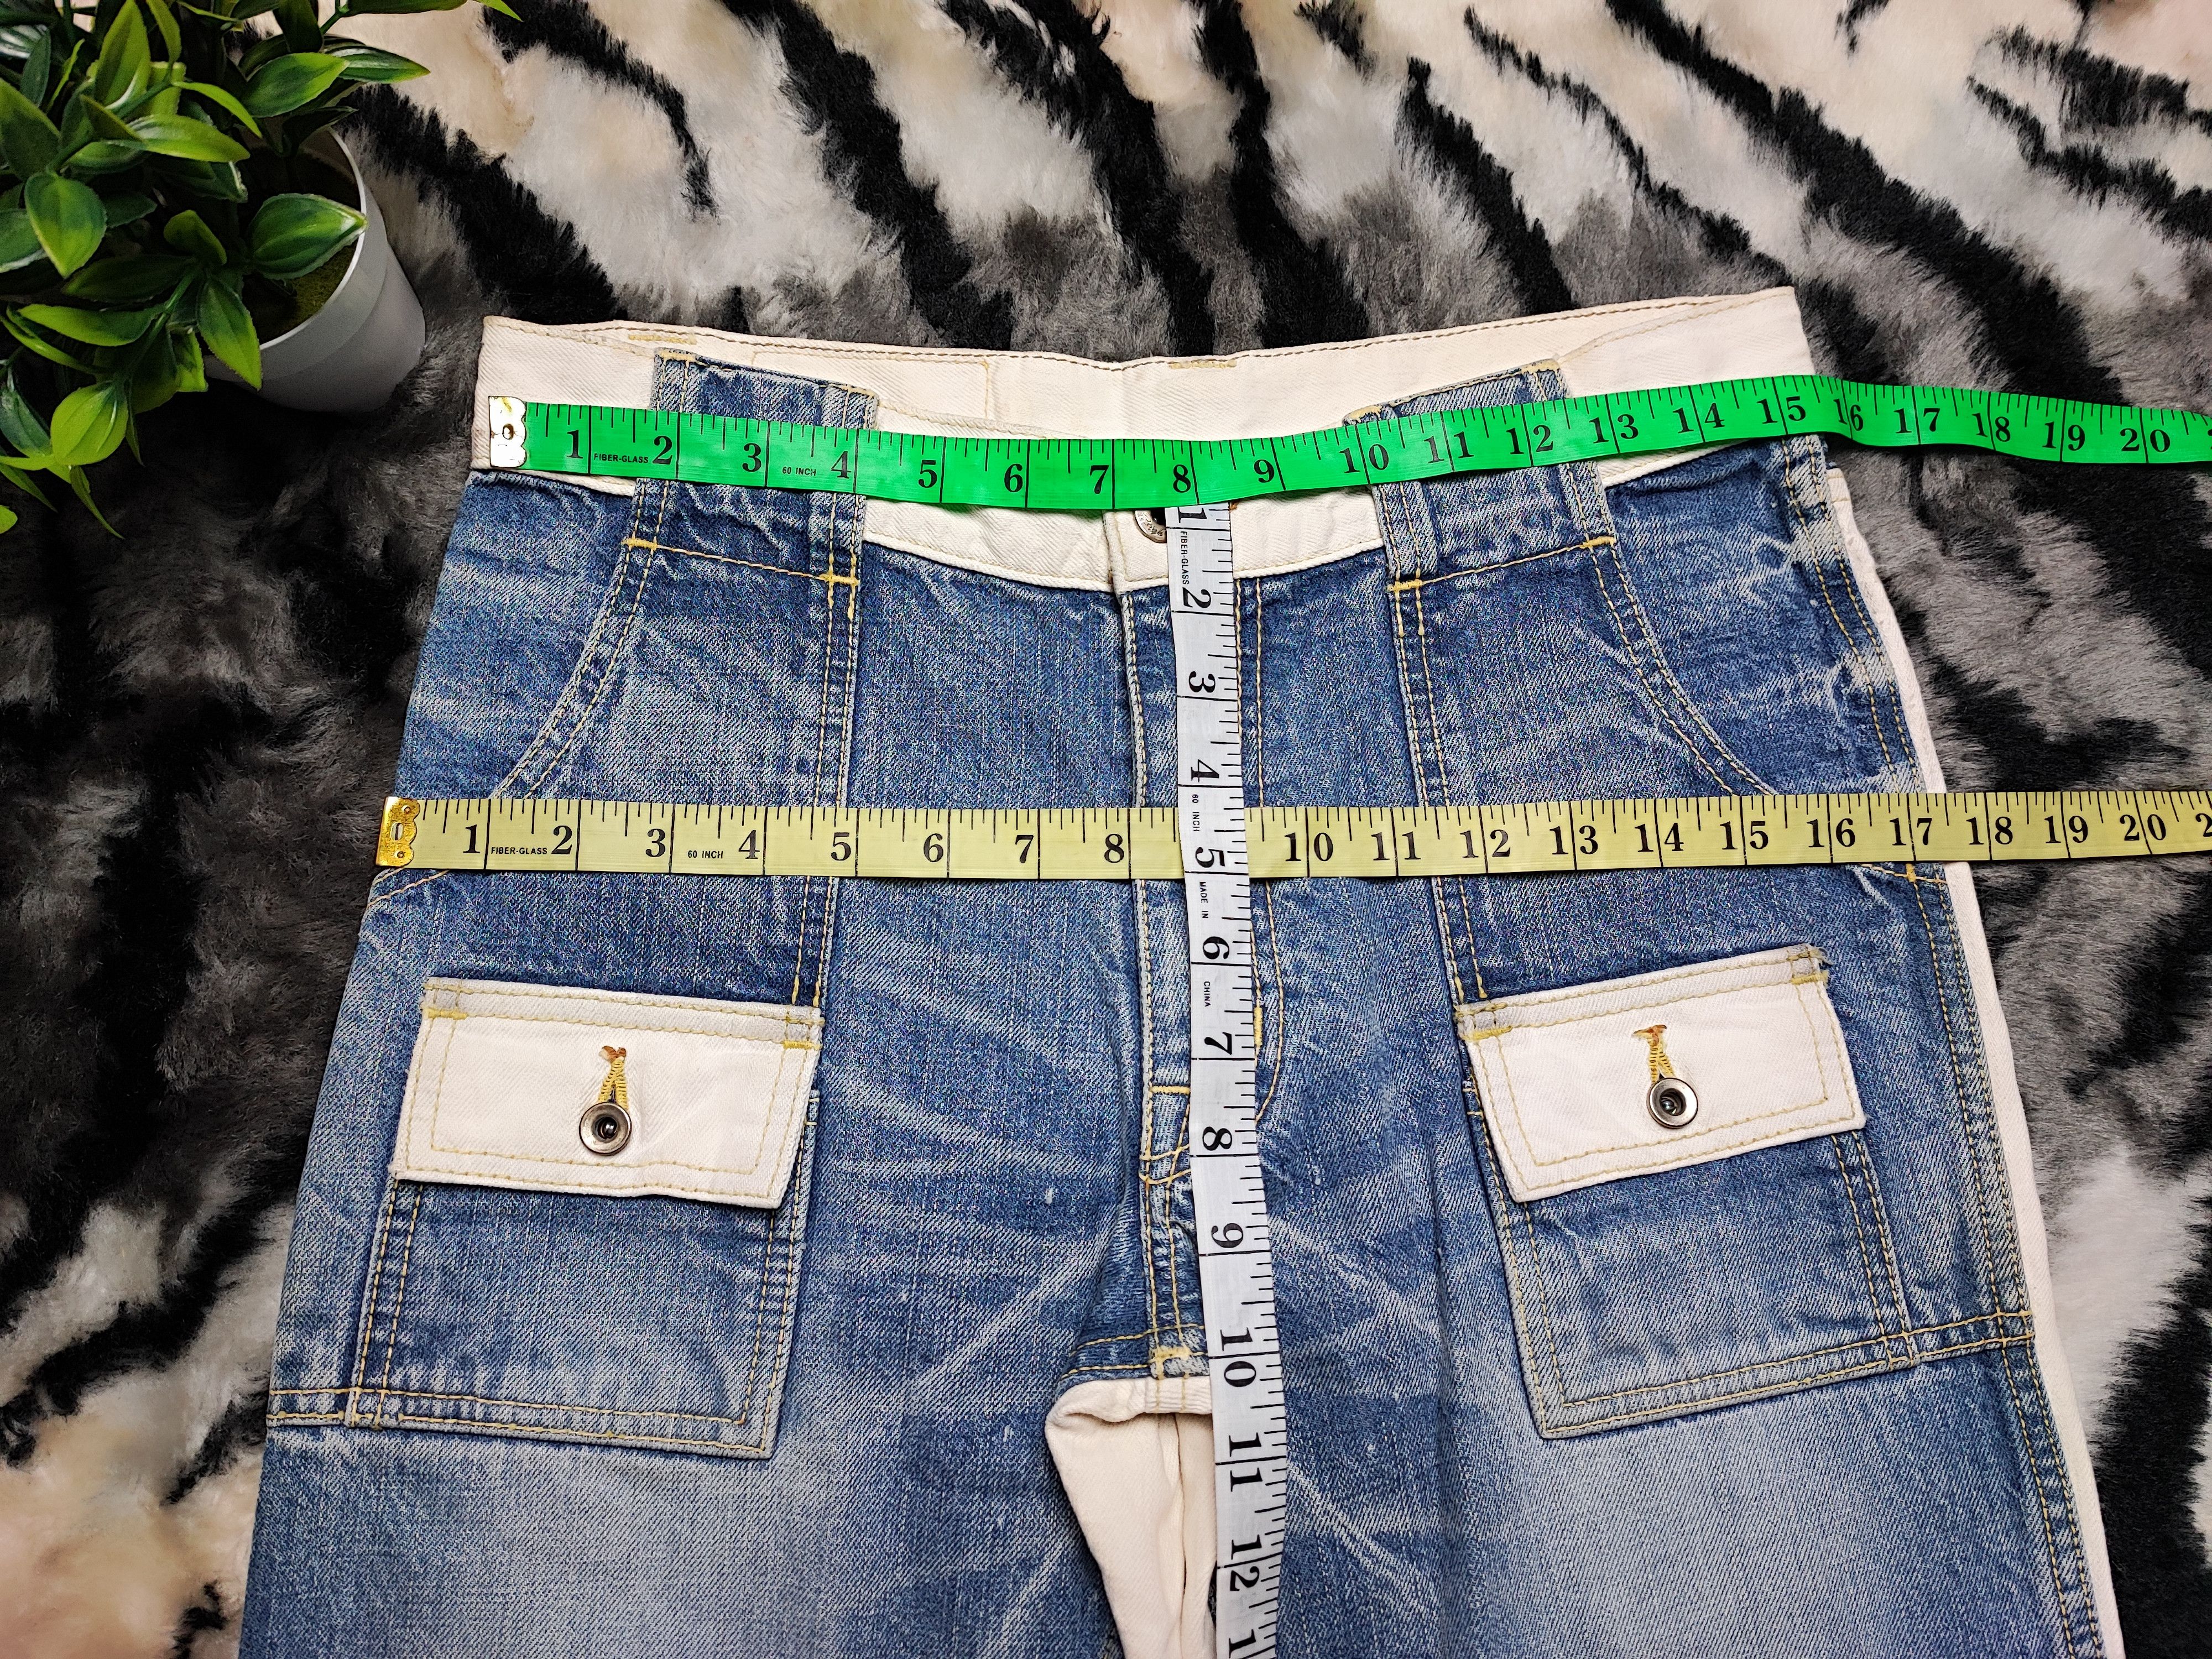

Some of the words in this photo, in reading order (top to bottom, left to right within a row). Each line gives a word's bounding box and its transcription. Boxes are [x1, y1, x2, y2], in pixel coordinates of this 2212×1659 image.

[567, 430, 583, 459] 1
[653, 435, 673, 465] 2
[742, 443, 761, 472] 3
[830, 451, 852, 479] 4
[918, 460, 937, 488] 5
[1004, 465, 1023, 492] 6
[1089, 465, 1109, 494] 7
[1172, 465, 1192, 493] 8
[1254, 460, 1274, 483] 9
[1340, 444, 1389, 474] 10
[1424, 431, 1474, 464] 11
[1506, 424, 1554, 455] 12
[1588, 413, 1639, 444] 13
[1673, 403, 1725, 434] 14
[1757, 395, 1806, 425] 15
[1834, 398, 1864, 432] 16
[1894, 408, 1941, 434] 17
[1973, 413, 2011, 442] 18
[2042, 421, 2086, 451] 19
[2120, 427, 2171, 452] 20
[594, 453, 649, 463] FIBER-GLASS
[796, 467, 816, 476] INCH
[1177, 507, 1207, 524] 1
[1181, 531, 1190, 585] FIBER-GLASS
[1182, 587, 1211, 609] 2
[1188, 671, 1216, 693] 3
[1191, 759, 1219, 782] 4
[1192, 794, 1199, 804] 60
[463, 825, 481, 854] 1
[551, 825, 573, 855] 2
[645, 828, 666, 858] 3
[738, 830, 760, 860] 4
[831, 832, 852, 861] 5
[924, 833, 944, 863] 6
[1014, 834, 1034, 864] 7
[1104, 834, 1125, 863] 8
[1285, 832, 1333, 862] 10
[1371, 831, 1421, 861] 11
[1460, 829, 1511, 859] 12
[1551, 825, 1599, 855] 13
[1636, 822, 1684, 853] 14
[1719, 820, 1769, 850] 15
[1808, 818, 1856, 848] 16
[1890, 817, 1932, 847] 17
[1967, 816, 2013, 845] 18
[2044, 815, 2089, 844] 19
[2119, 813, 2167, 841] 20
[491, 847, 547, 855] FIBER-GLASS
[687, 850, 698, 859] 60
[701, 851, 724, 859] INCH
[1195, 847, 1225, 868] 5
[1199, 881, 1208, 903] MADE
[1202, 936, 1230, 959] 6
[1204, 1032, 1233, 1056] 7
[1202, 1126, 1233, 1151] 8
[1211, 1223, 1244, 1248] 9
[1220, 1327, 1256, 1387] 10
[1229, 1432, 1263, 1492] 11
[1230, 1534, 1262, 1592] 12
